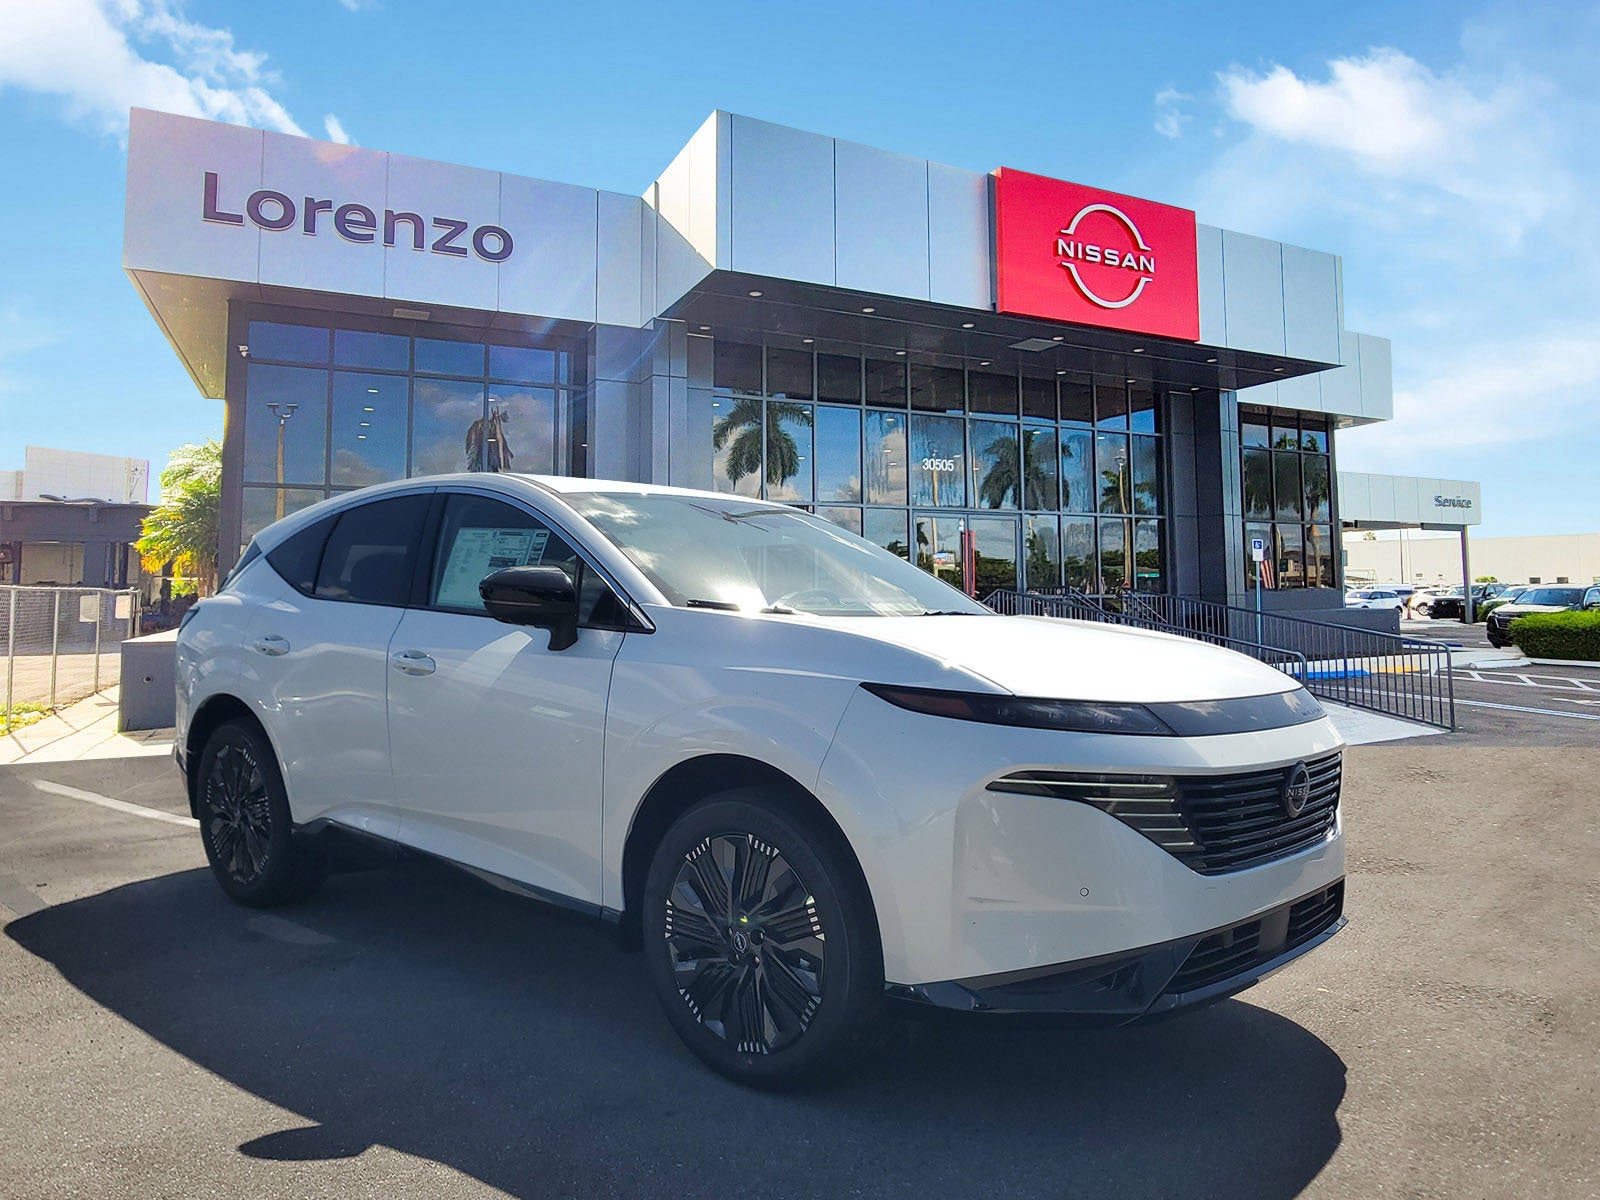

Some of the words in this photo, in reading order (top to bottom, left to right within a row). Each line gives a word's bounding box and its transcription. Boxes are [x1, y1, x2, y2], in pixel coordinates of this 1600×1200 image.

[202, 171, 514, 262] Lorenzo
[1057, 238, 1155, 273] NISSAN
[922, 458, 954, 471] 30505
[1434, 495, 1472, 509] Service
